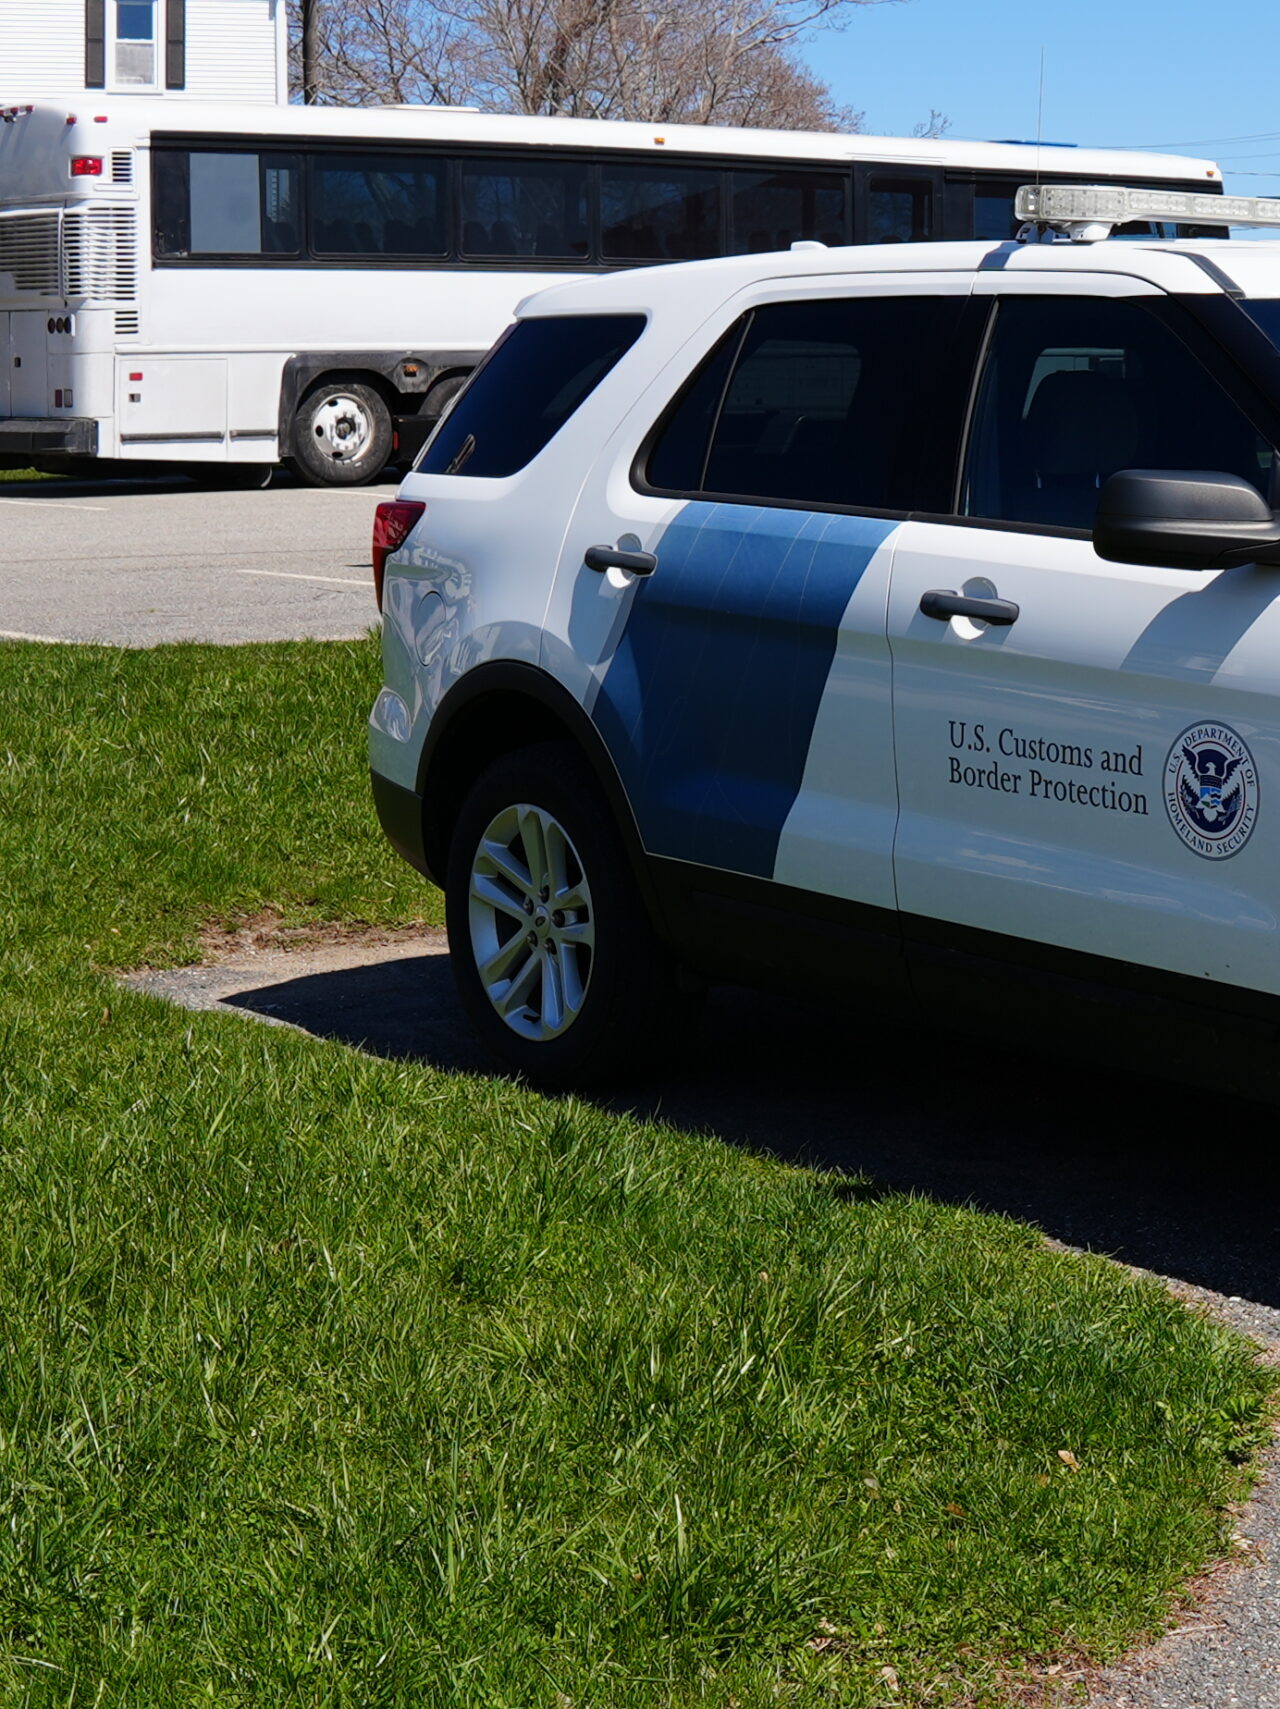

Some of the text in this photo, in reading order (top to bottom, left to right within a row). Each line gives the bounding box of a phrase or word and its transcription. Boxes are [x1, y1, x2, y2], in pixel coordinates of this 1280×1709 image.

[948, 720, 1144, 776] U.S. Customs and
[1184, 727, 1249, 766] DEPARTMENT
[1245, 770, 1256, 787] OF
[949, 757, 1149, 816] Border Protection
[1167, 792, 1255, 855] HOMELAND SECURITY
